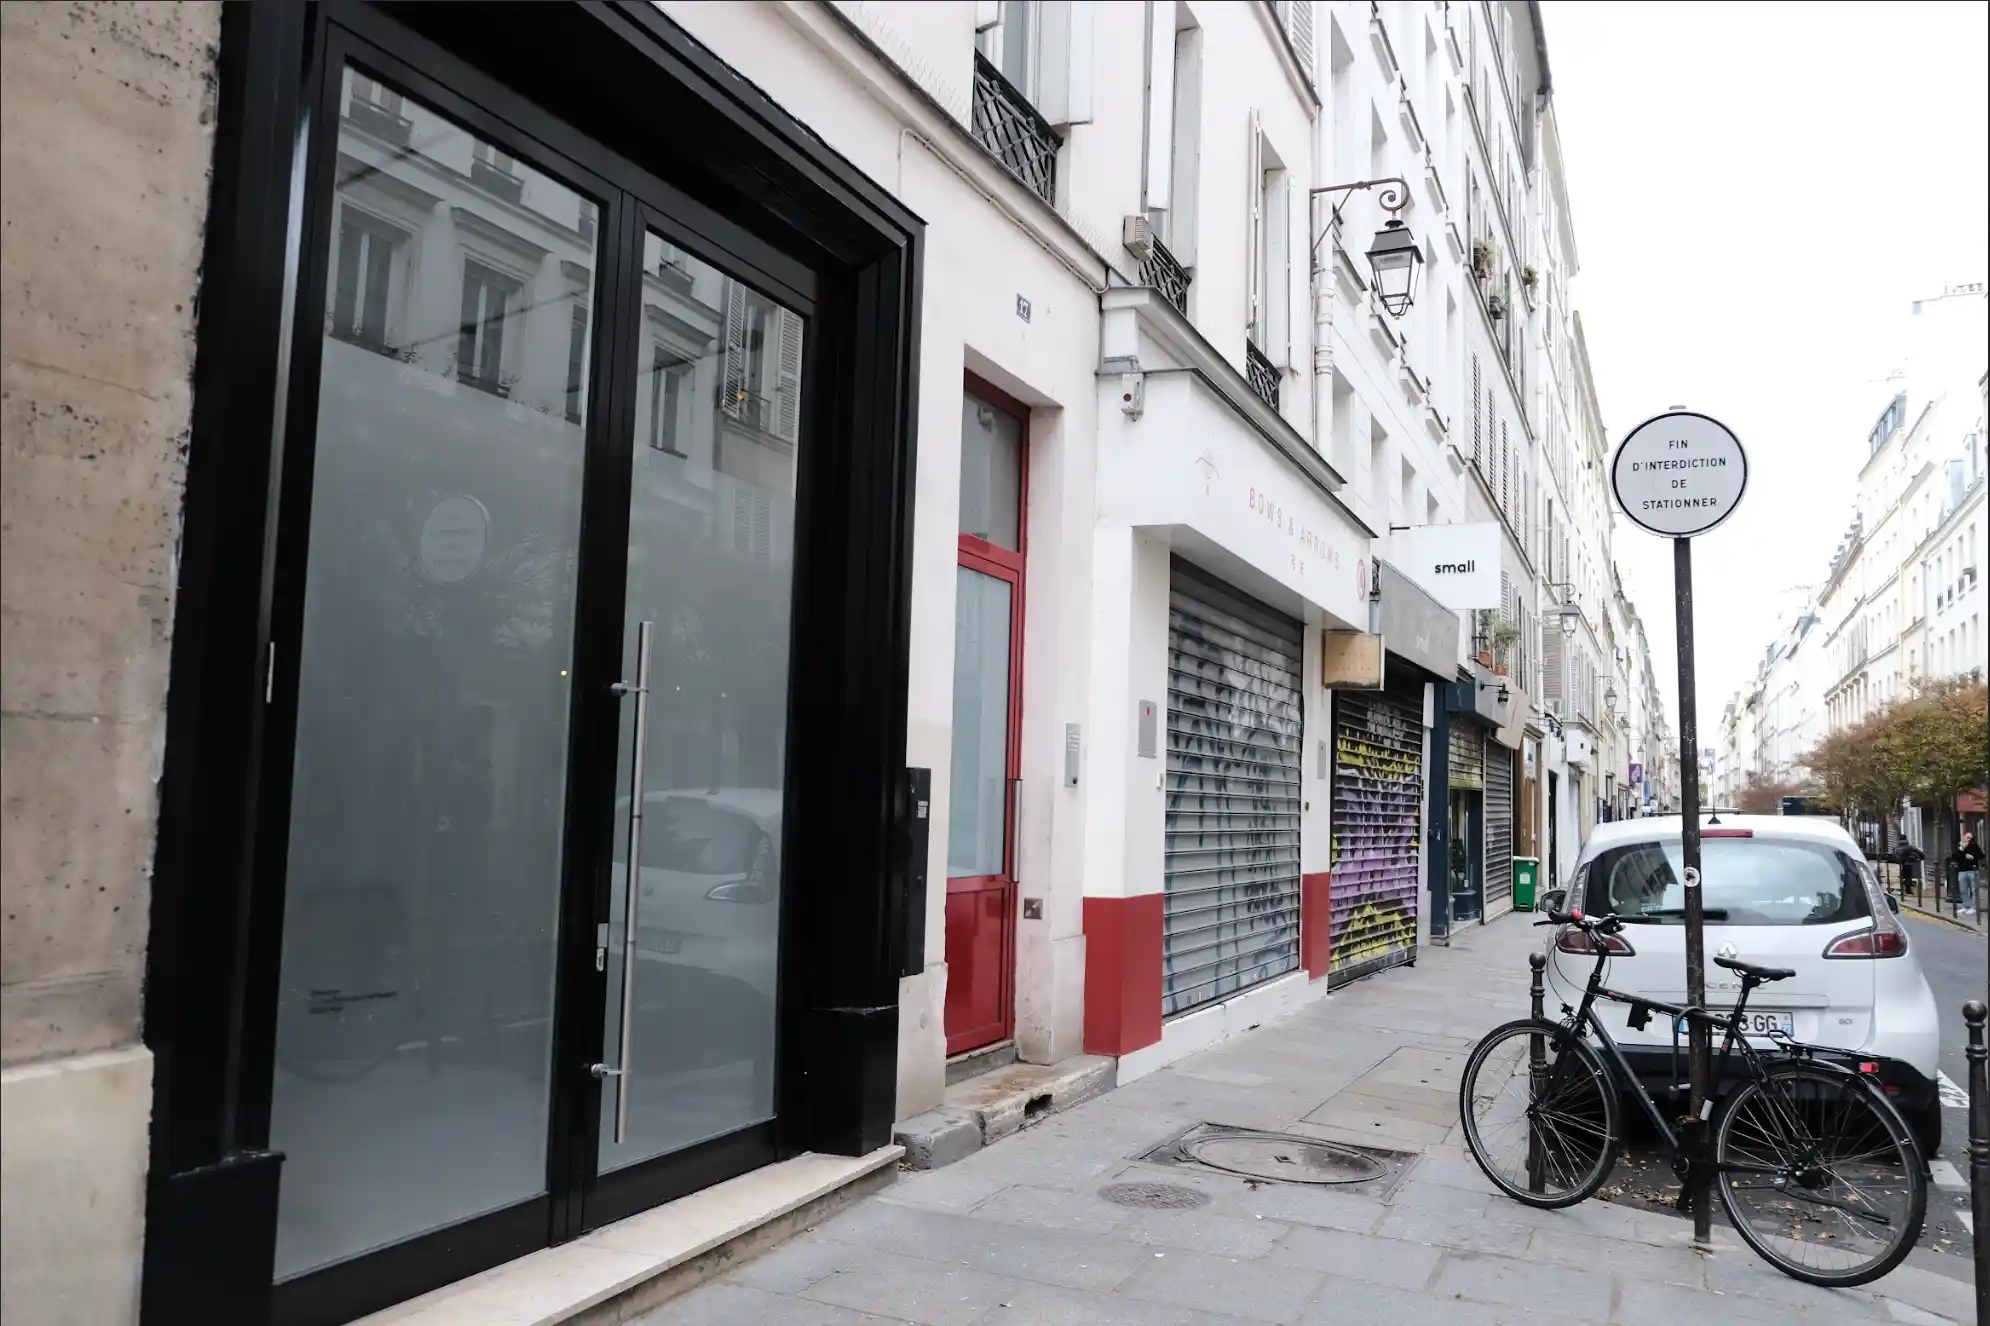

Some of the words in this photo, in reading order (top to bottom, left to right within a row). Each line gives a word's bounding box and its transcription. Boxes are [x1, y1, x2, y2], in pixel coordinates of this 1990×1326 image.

[1669, 440, 1688, 449] FIN
[1632, 458, 1726, 471] D'INTERDICTION
[1671, 479, 1687, 489] DE
[1642, 498, 1717, 509] STATIONNER
[1249, 486, 1283, 529] BOWS
[1288, 516, 1294, 537] &
[1300, 525, 1340, 570] ARROWS
[1434, 560, 1475, 574] small
